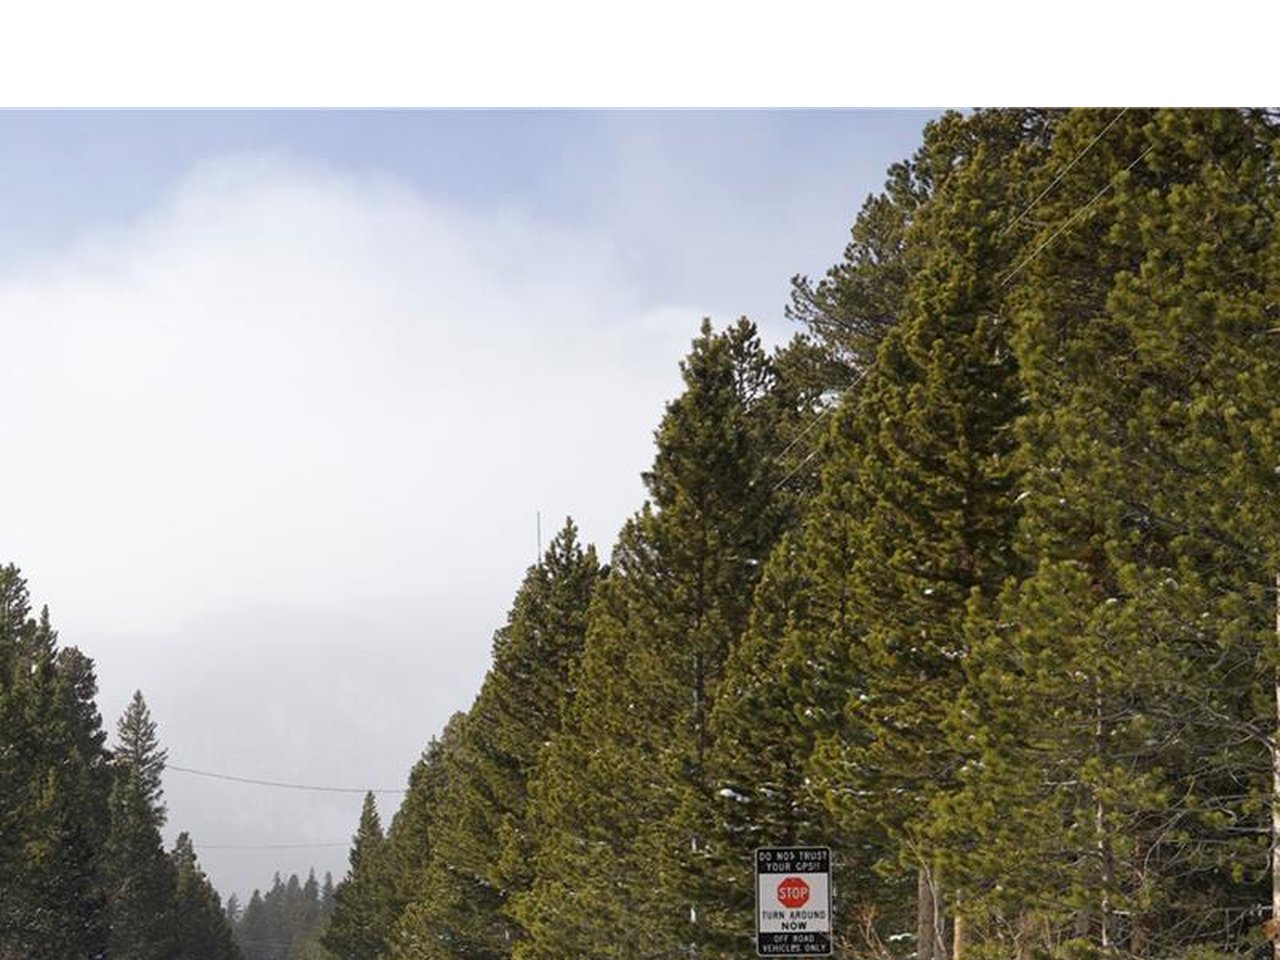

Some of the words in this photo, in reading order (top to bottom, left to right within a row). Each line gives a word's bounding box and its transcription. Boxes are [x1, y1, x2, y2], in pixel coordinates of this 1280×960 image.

[759, 851, 773, 861] DO
[800, 850, 827, 861] TRUST
[766, 862, 792, 871] YOUR
[778, 887, 809, 900] STOP
[762, 911, 785, 920] TURN
[790, 911, 826, 920] AROUND
[781, 921, 807, 930] NOW
[774, 935, 788, 943] OFF
[793, 935, 815, 943] ROAD
[762, 944, 802, 953] VEHICLES
[804, 944, 826, 953] ONLY
